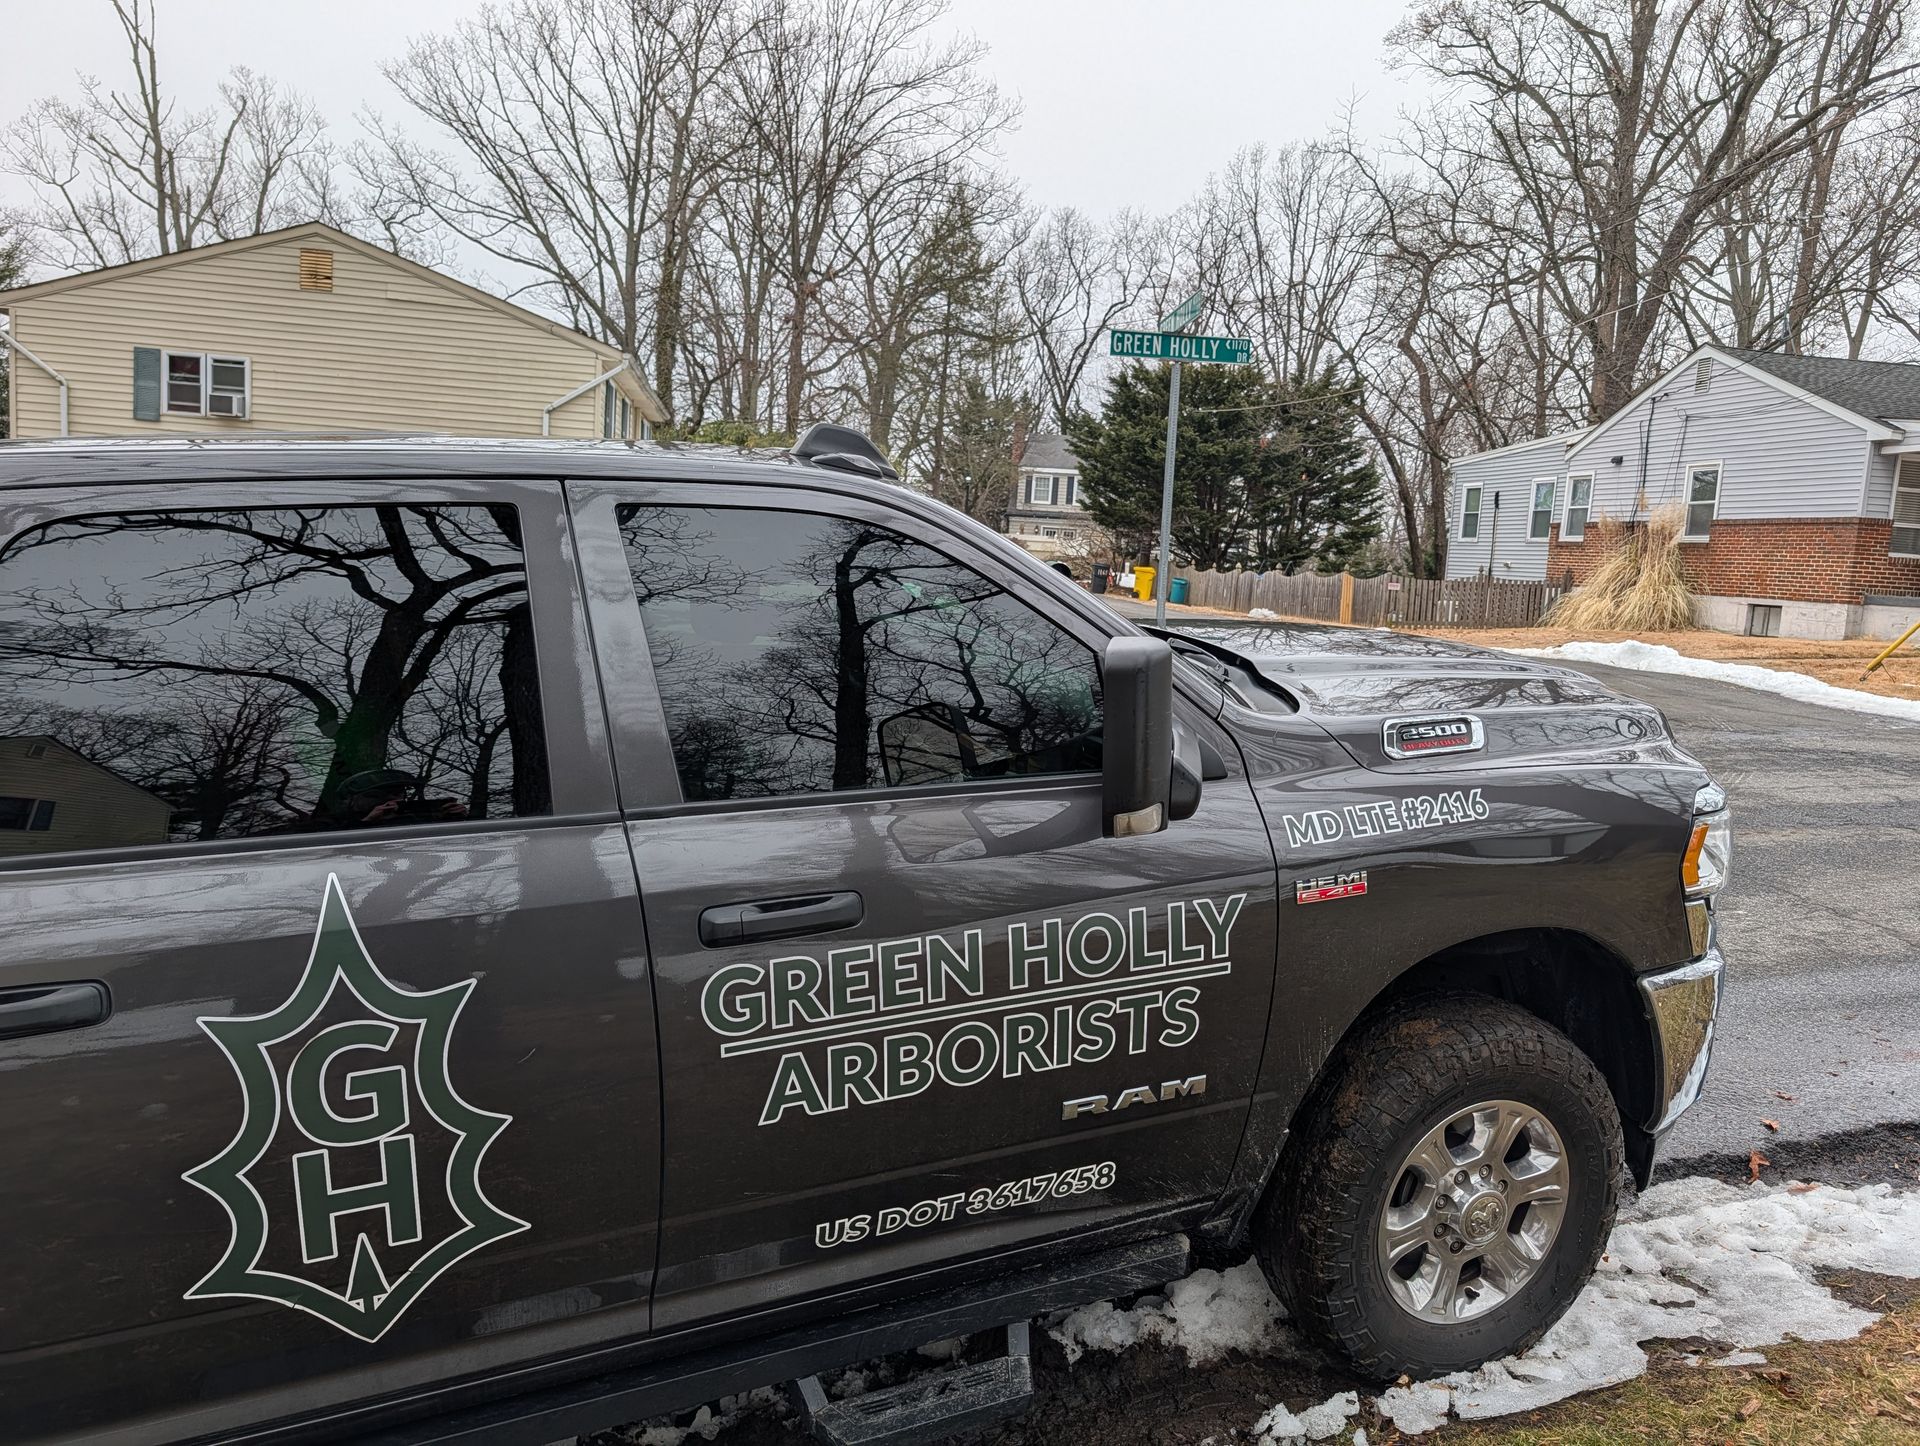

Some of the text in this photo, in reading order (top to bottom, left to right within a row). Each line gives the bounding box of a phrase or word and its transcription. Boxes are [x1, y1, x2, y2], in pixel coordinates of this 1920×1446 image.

[1113, 332, 1220, 359] GREEN HOLLY
[1236, 352, 1248, 363] DR
[1401, 723, 1468, 741] 2500
[1282, 788, 1490, 848] MD LTE #2416
[1296, 871, 1368, 891] HEMI
[701, 893, 1248, 1037] GREEN HOLLY
[757, 986, 1201, 1126] ARBORISTS
[1061, 1074, 1207, 1121] RAM
[815, 1160, 1117, 1249] US DOT 3617658
